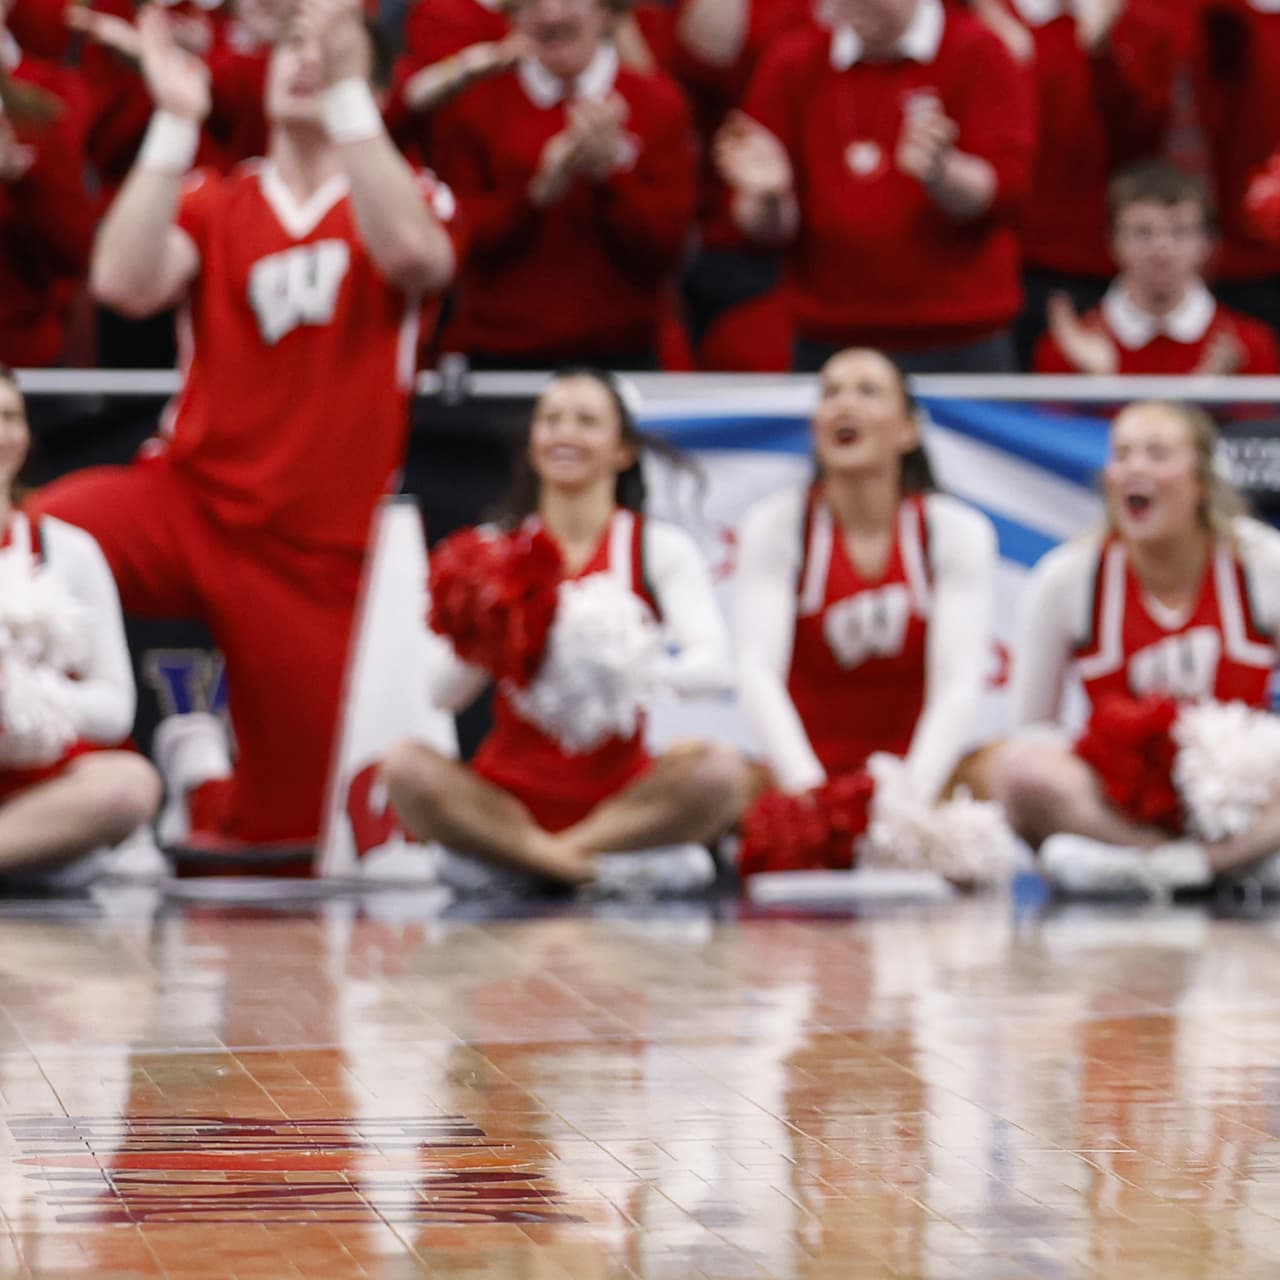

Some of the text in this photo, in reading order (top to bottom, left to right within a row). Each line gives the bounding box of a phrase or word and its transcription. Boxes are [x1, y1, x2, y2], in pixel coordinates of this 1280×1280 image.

[248, 238, 350, 347] W
[822, 581, 911, 671] W
[1127, 625, 1223, 704] W
